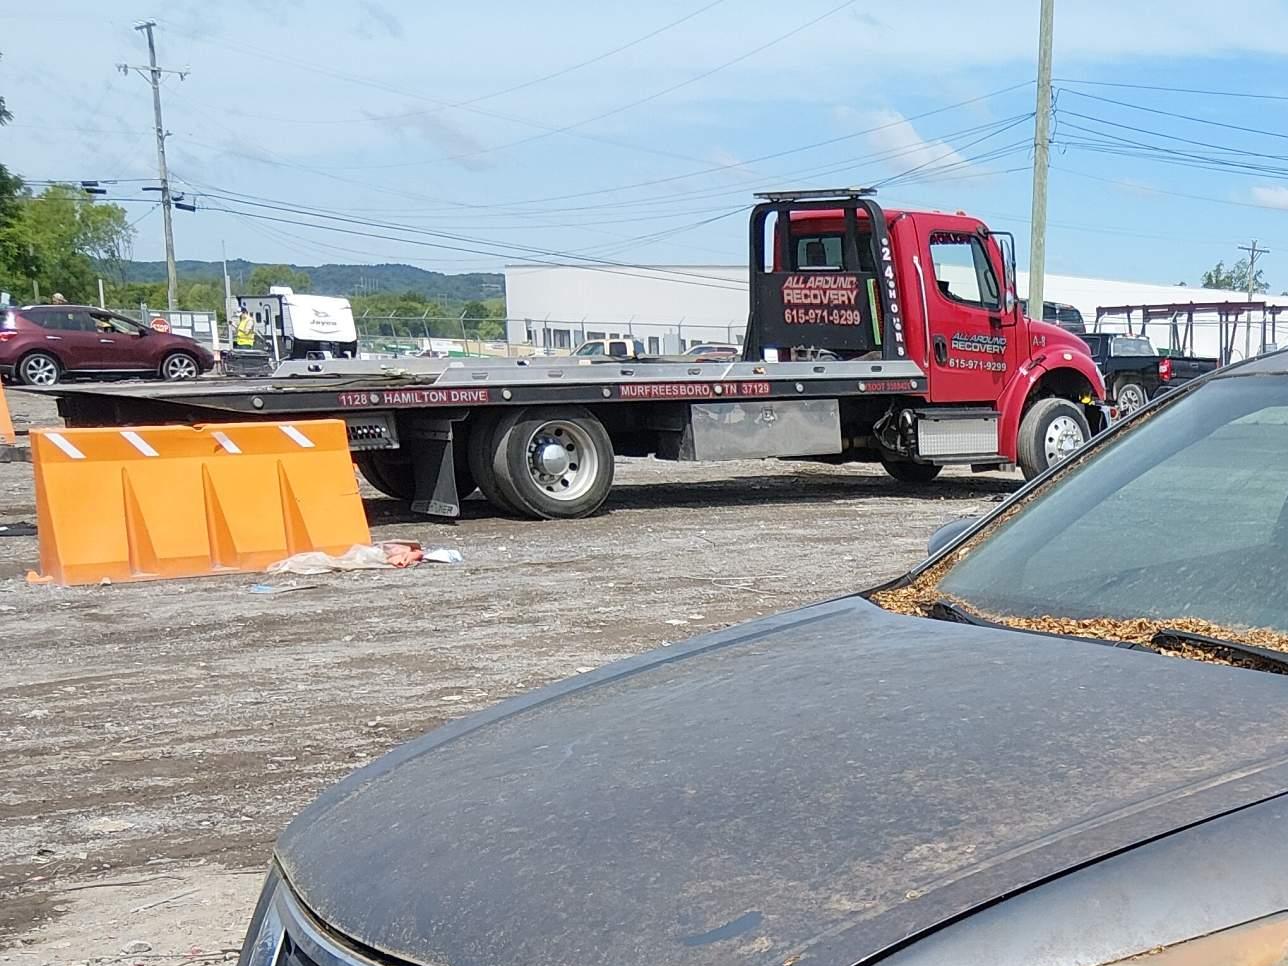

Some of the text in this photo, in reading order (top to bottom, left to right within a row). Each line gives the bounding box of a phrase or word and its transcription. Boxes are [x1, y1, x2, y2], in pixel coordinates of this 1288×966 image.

[783, 276, 857, 289] ALL AROUND
[783, 289, 858, 305] RECOVERY
[784, 308, 861, 325] 615-971-9299
[952, 332, 1007, 345] ALL AROUND
[951, 340, 1007, 354] RECOVERY
[949, 358, 1007, 372] 615-971-9299
[621, 383, 769, 398] MURFREESBORO, TN 37129
[340, 390, 487, 406] 1128 HAMILTON DRIVE
